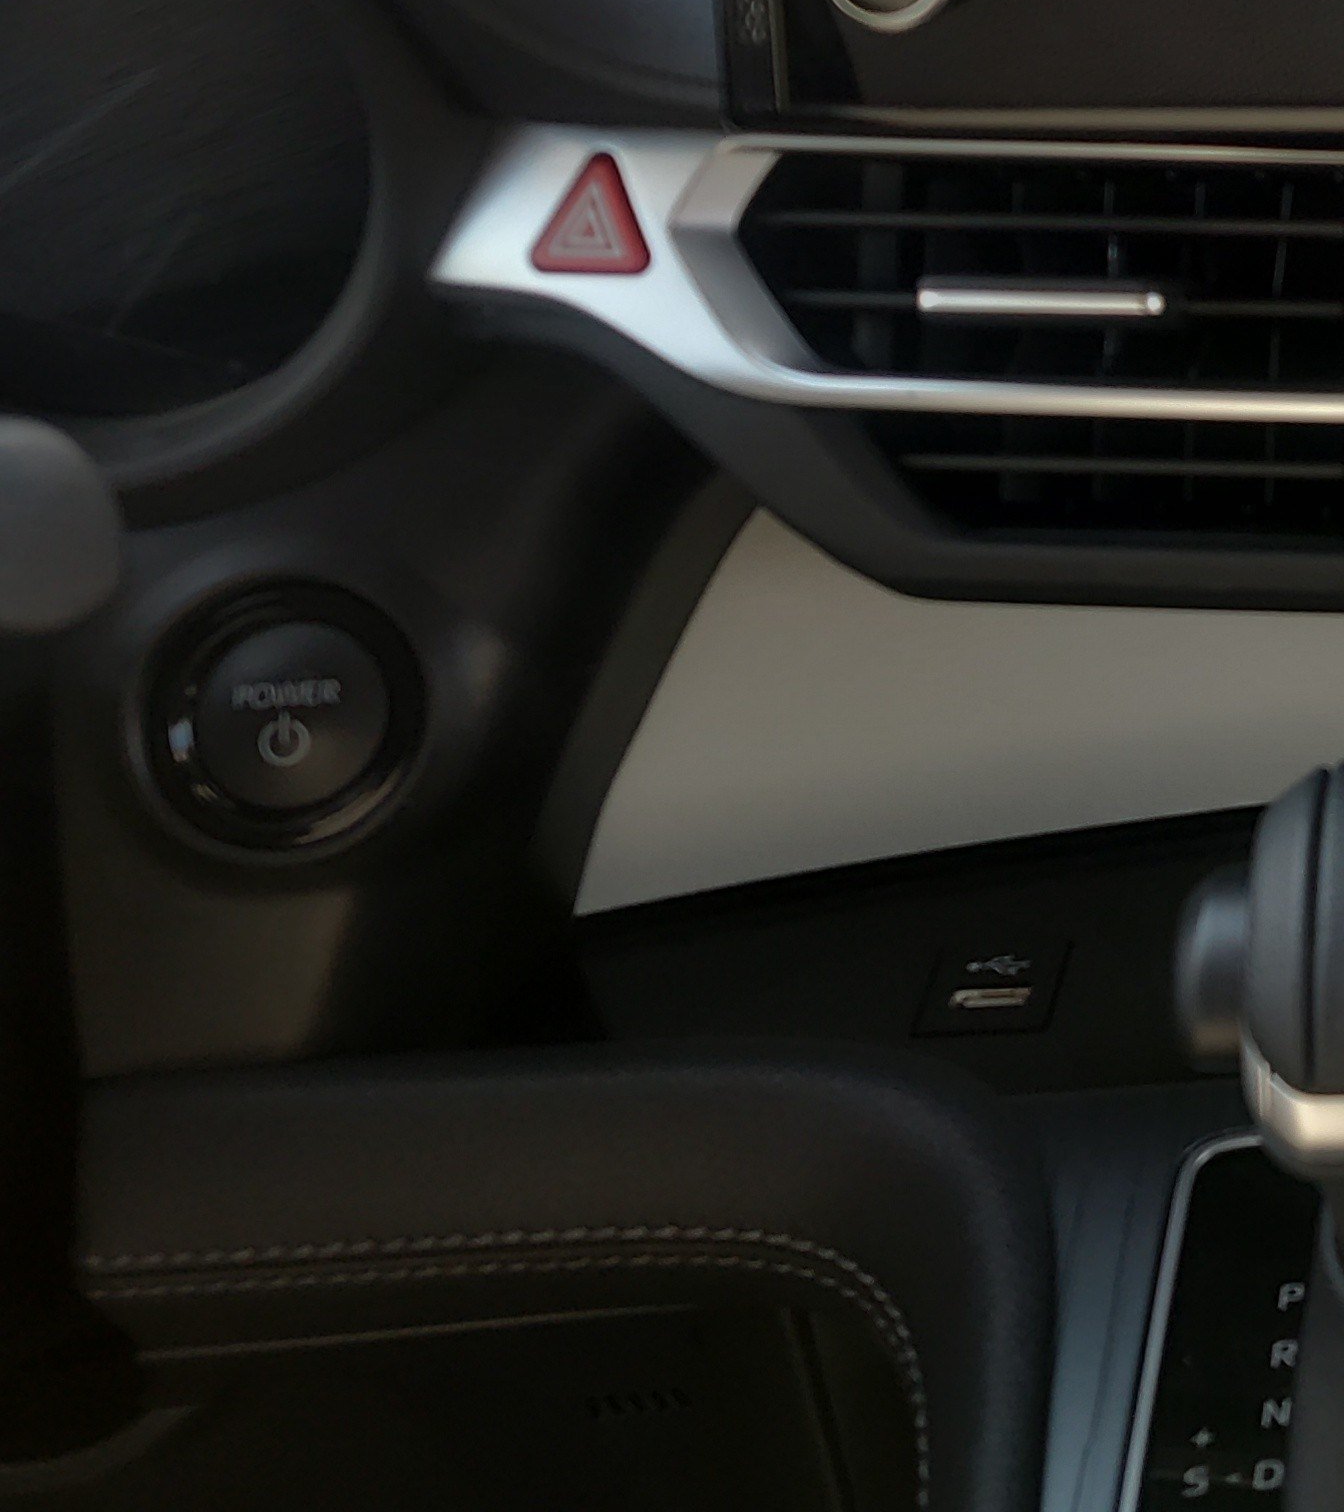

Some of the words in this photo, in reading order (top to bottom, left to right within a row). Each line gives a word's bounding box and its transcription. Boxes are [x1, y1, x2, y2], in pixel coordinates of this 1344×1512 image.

[231, 678, 342, 710] POWER
[1277, 1281, 1306, 1312] P
[1270, 1338, 1299, 1369] R
[1260, 1396, 1293, 1429] N
[1181, 1464, 1210, 1498] S
[1252, 1457, 1286, 1491] D
